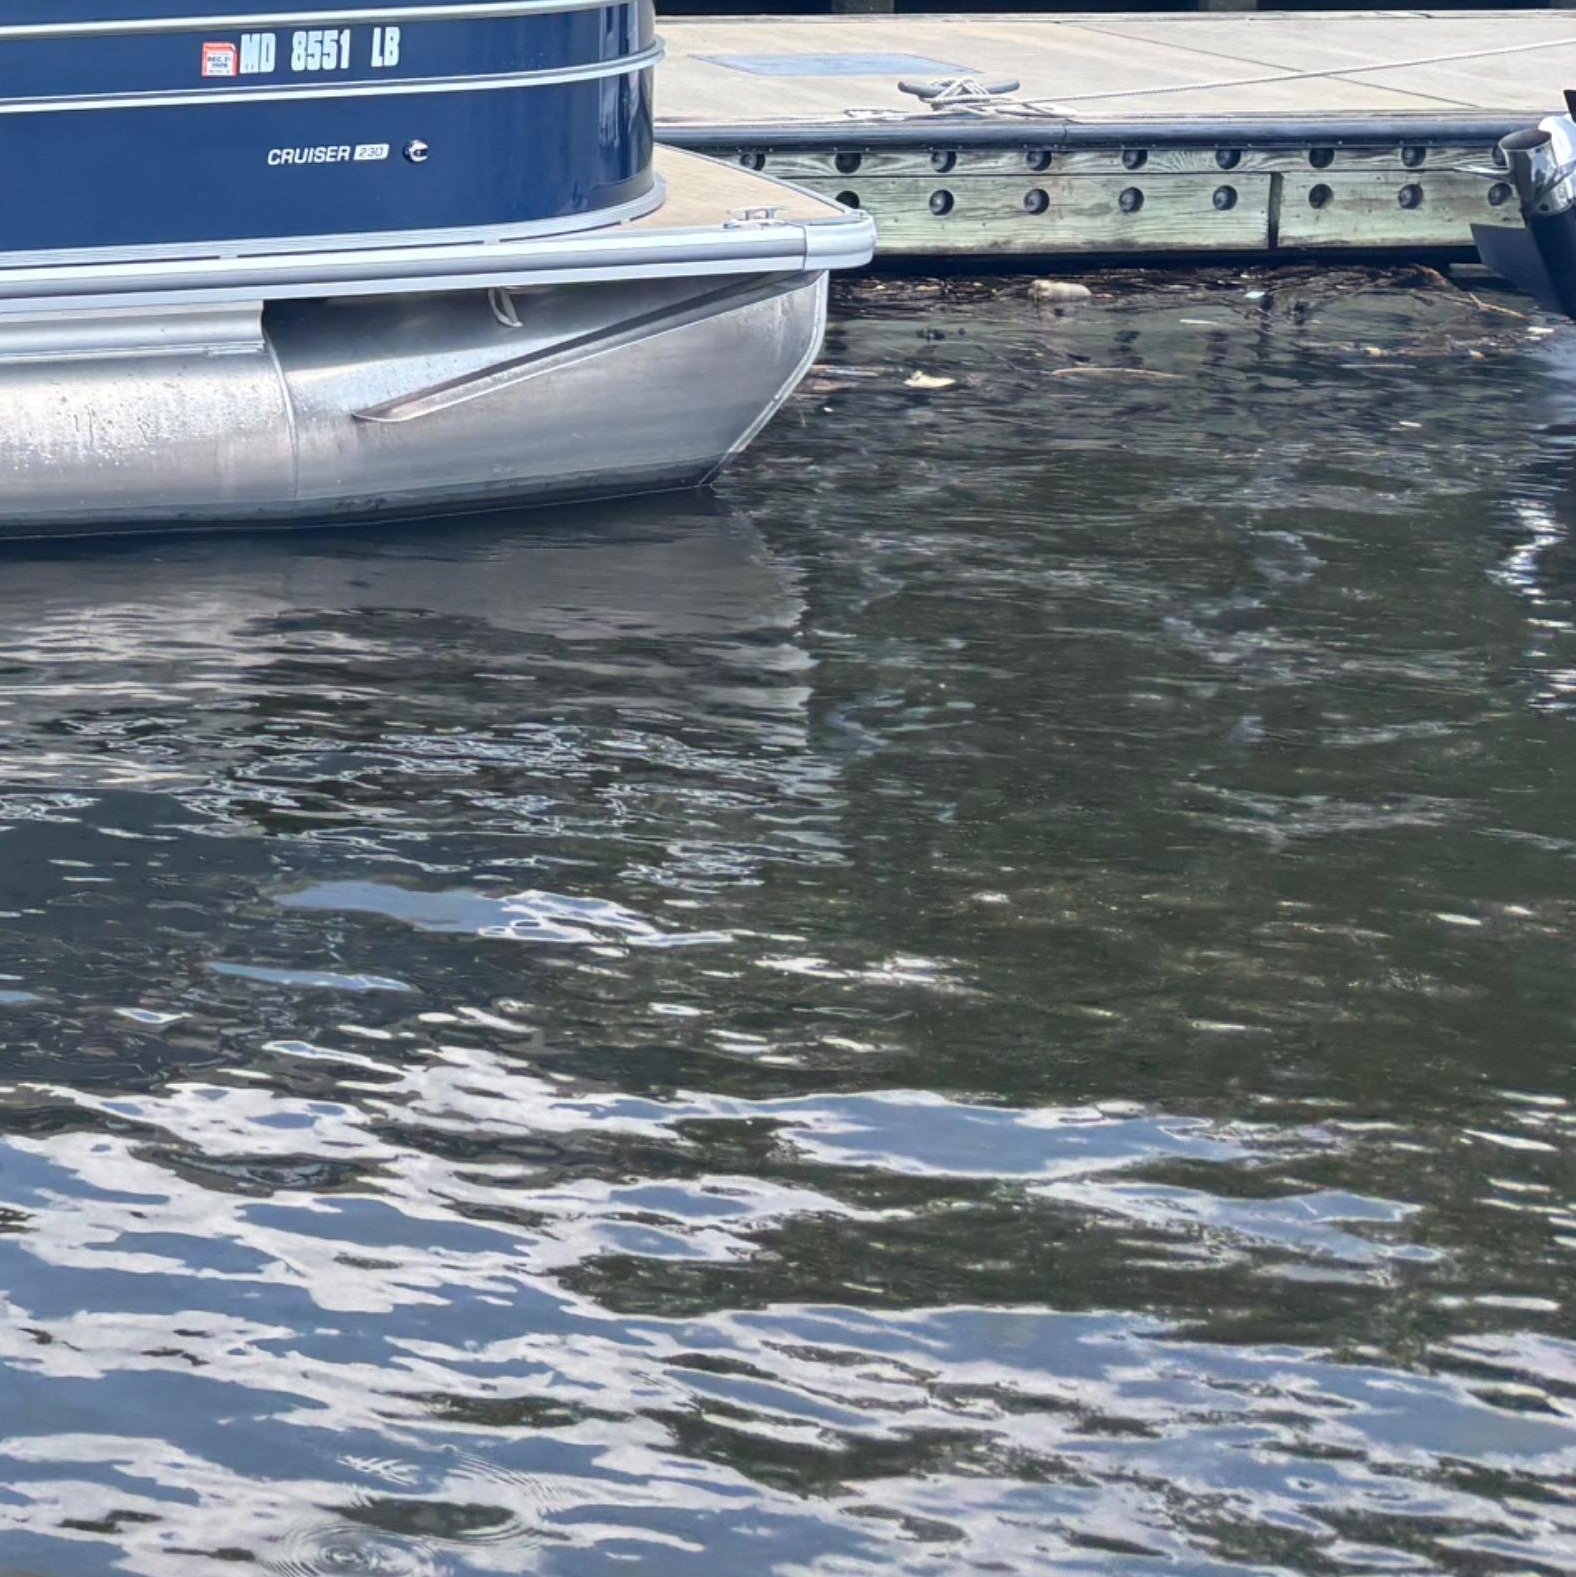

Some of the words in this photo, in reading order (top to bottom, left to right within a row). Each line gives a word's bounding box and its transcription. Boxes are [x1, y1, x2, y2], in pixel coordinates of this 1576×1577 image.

[239, 32, 276, 74] MD
[290, 28, 351, 72] 8551
[370, 26, 401, 68] LB
[267, 145, 350, 165] CRUISER
[358, 146, 383, 158] 230
